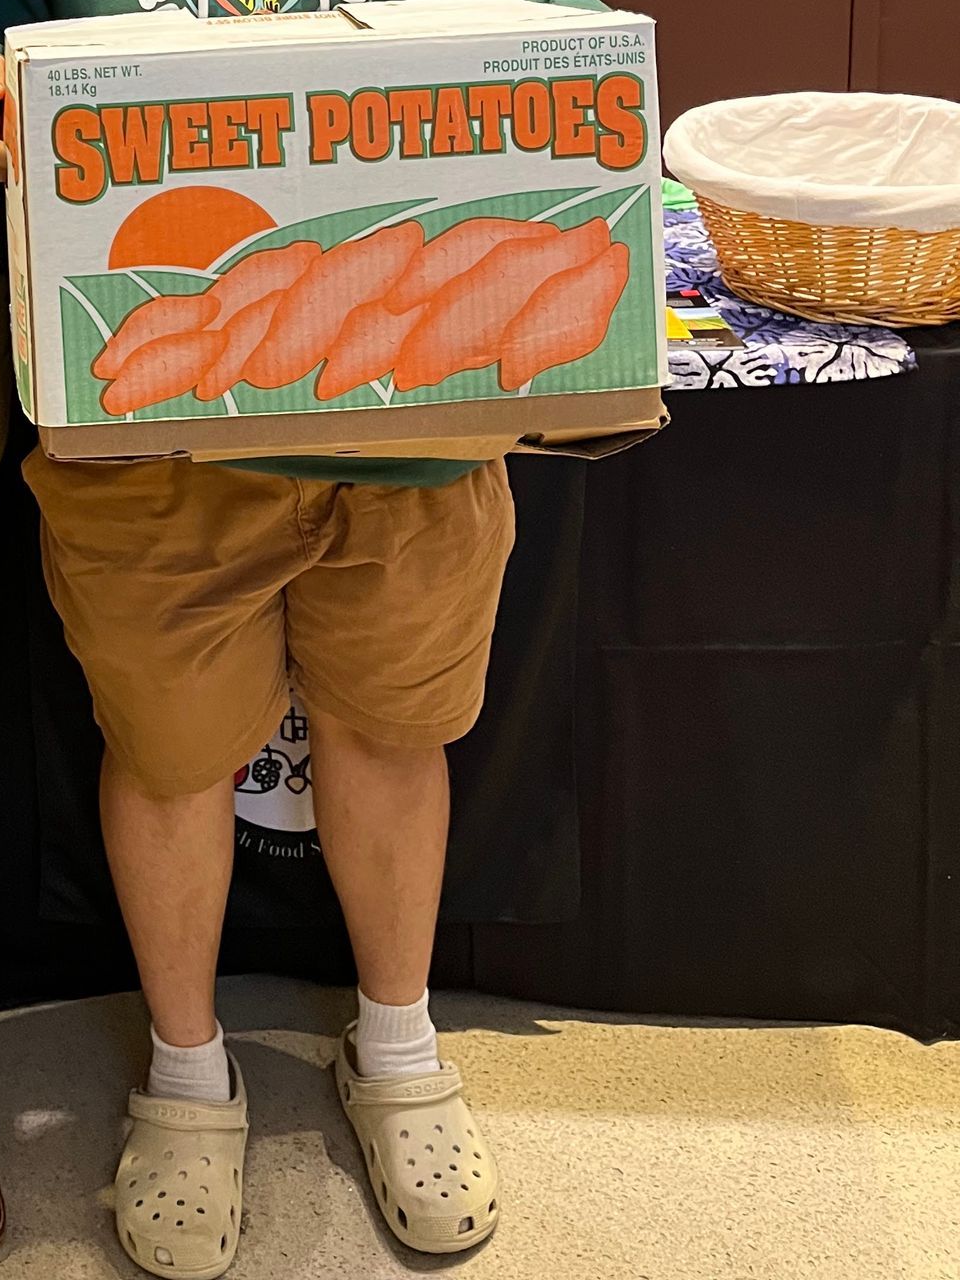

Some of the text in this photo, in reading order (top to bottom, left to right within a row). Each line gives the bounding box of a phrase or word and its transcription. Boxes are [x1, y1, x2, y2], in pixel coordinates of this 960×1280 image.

[522, 34, 645, 53] PRODUCT OF U.S.A.
[483, 51, 646, 73] PRODUIT DES ÉTATS-UNIS
[48, 65, 142, 81] 40 LBS. NET WT.
[48, 83, 97, 97] 18.14 Kg
[53, 71, 646, 205] SWEET POTATOES
